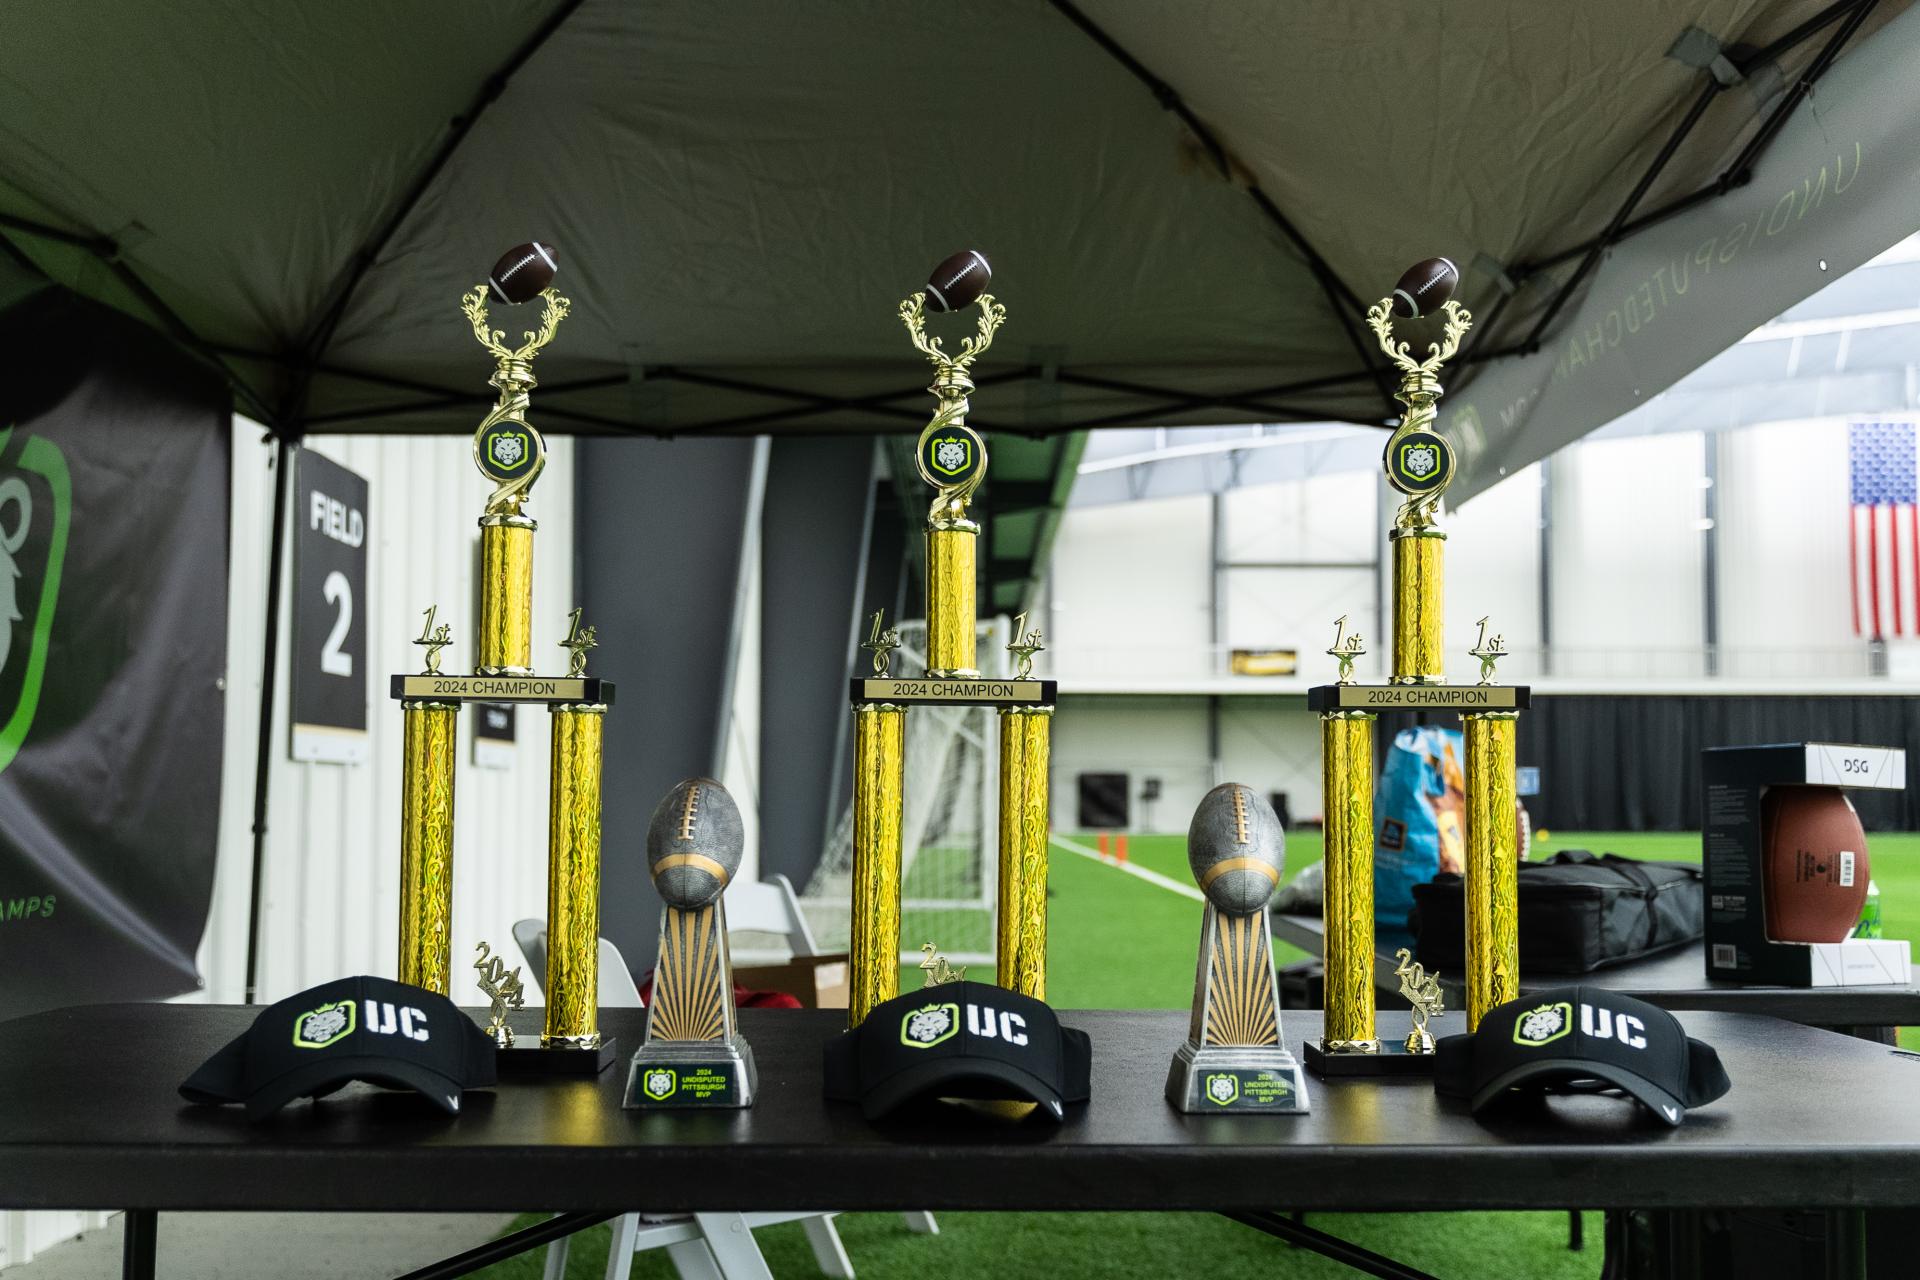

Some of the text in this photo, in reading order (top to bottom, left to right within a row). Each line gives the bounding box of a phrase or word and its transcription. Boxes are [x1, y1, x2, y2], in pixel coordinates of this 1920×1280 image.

[310, 489, 364, 548] FIELD
[321, 571, 353, 677] 2
[434, 681, 556, 695] 2024 CHAMPION
[893, 683, 1014, 697] 2024 CHAMPION
[1368, 690, 1488, 704] 2024 CHAMPION
[1844, 759, 1869, 773] DSG
[365, 999, 430, 1042] UC
[966, 1003, 1029, 1047] UC
[1580, 1003, 1648, 1049] UC
